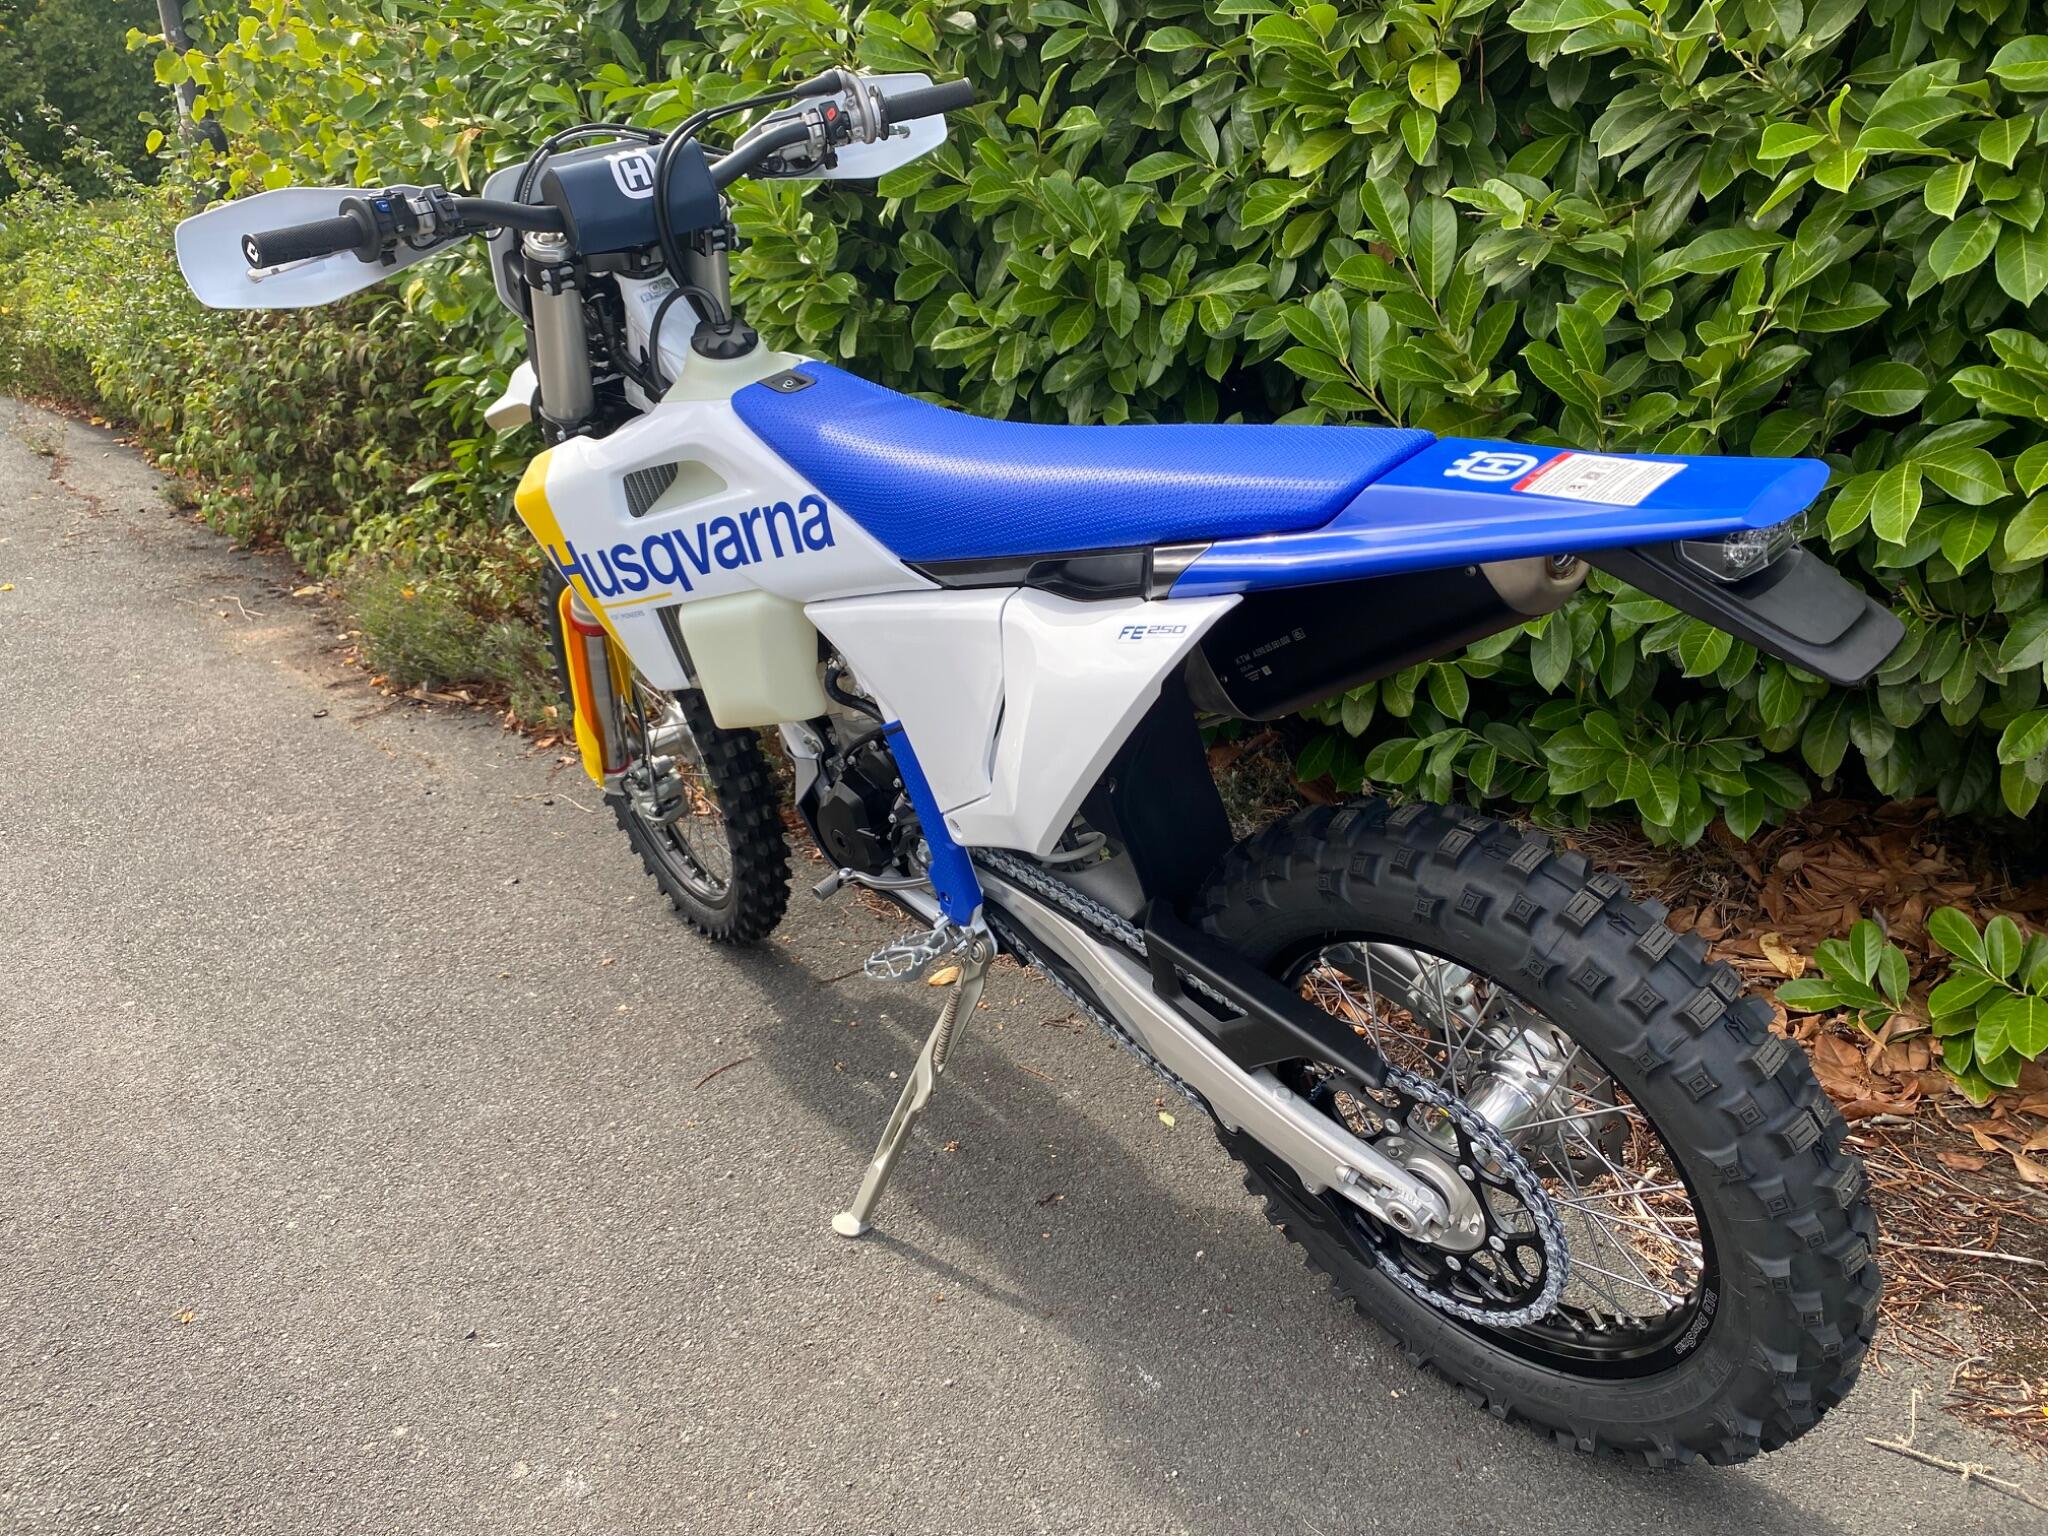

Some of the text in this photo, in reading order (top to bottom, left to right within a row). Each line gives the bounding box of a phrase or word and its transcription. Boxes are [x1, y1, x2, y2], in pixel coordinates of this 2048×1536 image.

[547, 494, 836, 599] Husqvarna
[1118, 624, 1187, 640] FE 250
